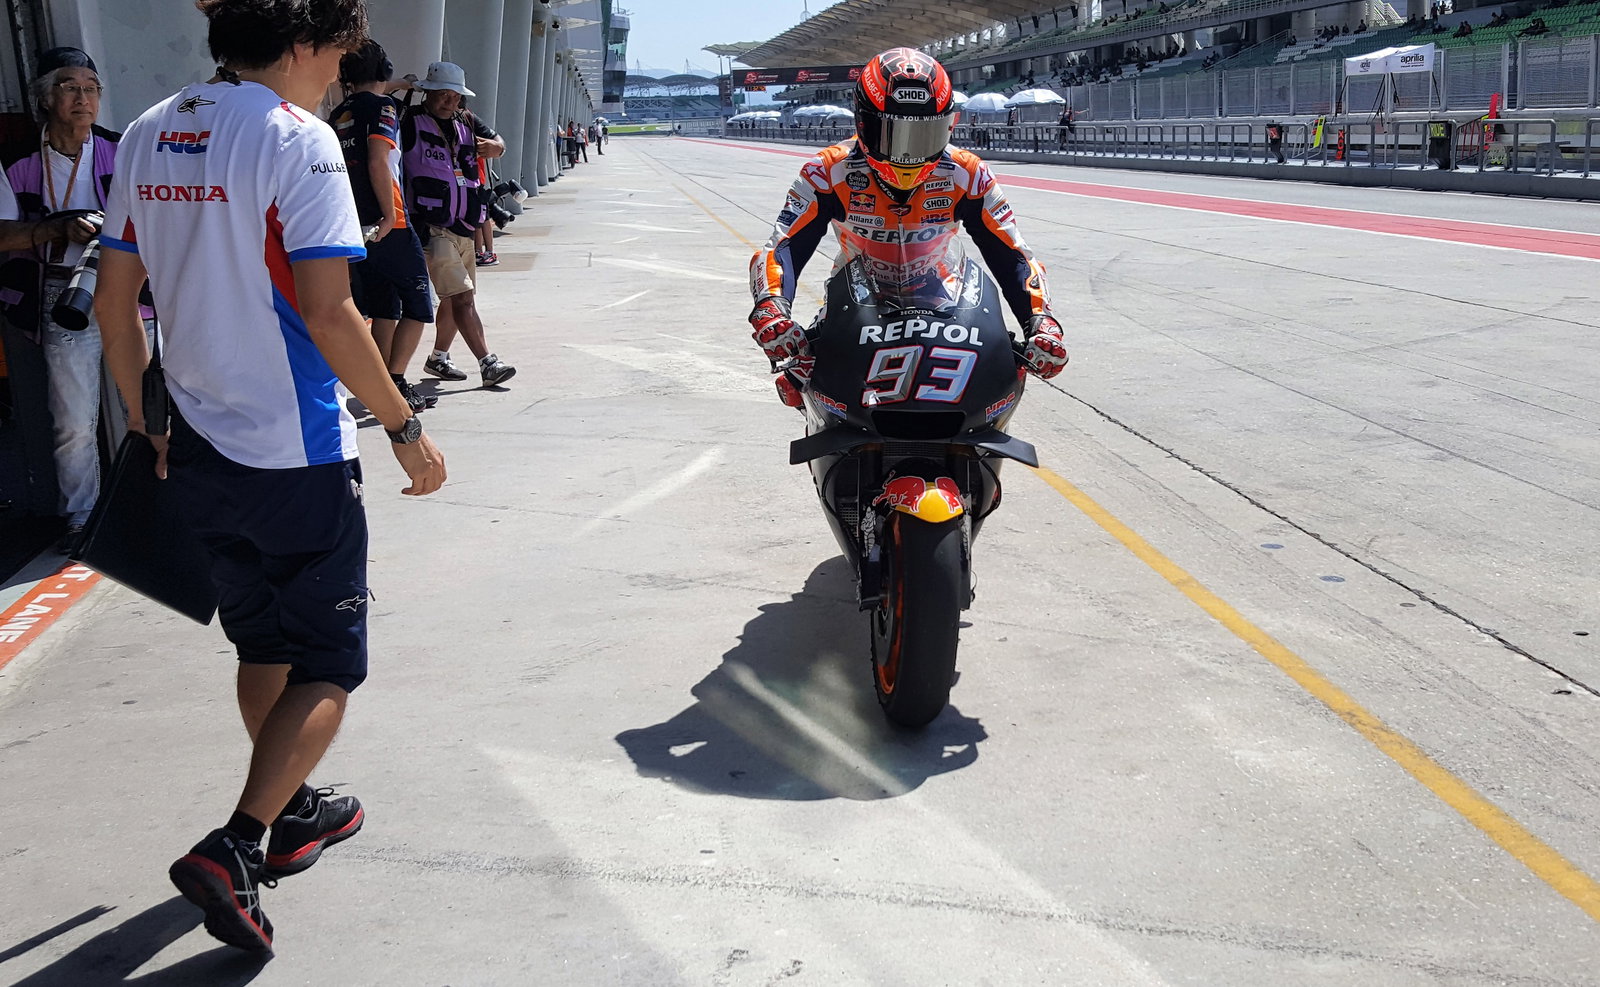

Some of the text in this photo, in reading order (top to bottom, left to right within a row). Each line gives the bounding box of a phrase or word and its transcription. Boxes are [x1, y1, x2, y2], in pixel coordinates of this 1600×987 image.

[1400, 54, 1424, 64] aprilia
[897, 90, 926, 100] SHOEI
[877, 112, 900, 121] GIVES
[923, 114, 945, 122] WINGS
[156, 130, 211, 155] HRC
[890, 156, 926, 164] PULL&BEAR
[925, 181, 952, 189] REPSOL
[136, 184, 229, 203] HONDA
[926, 198, 949, 209] SHOEI
[848, 214, 874, 224] Allianz
[858, 319, 983, 346] REPSOL
[861, 344, 978, 407] 93
[814, 391, 847, 420] HRC
[985, 391, 1015, 423] HRC
